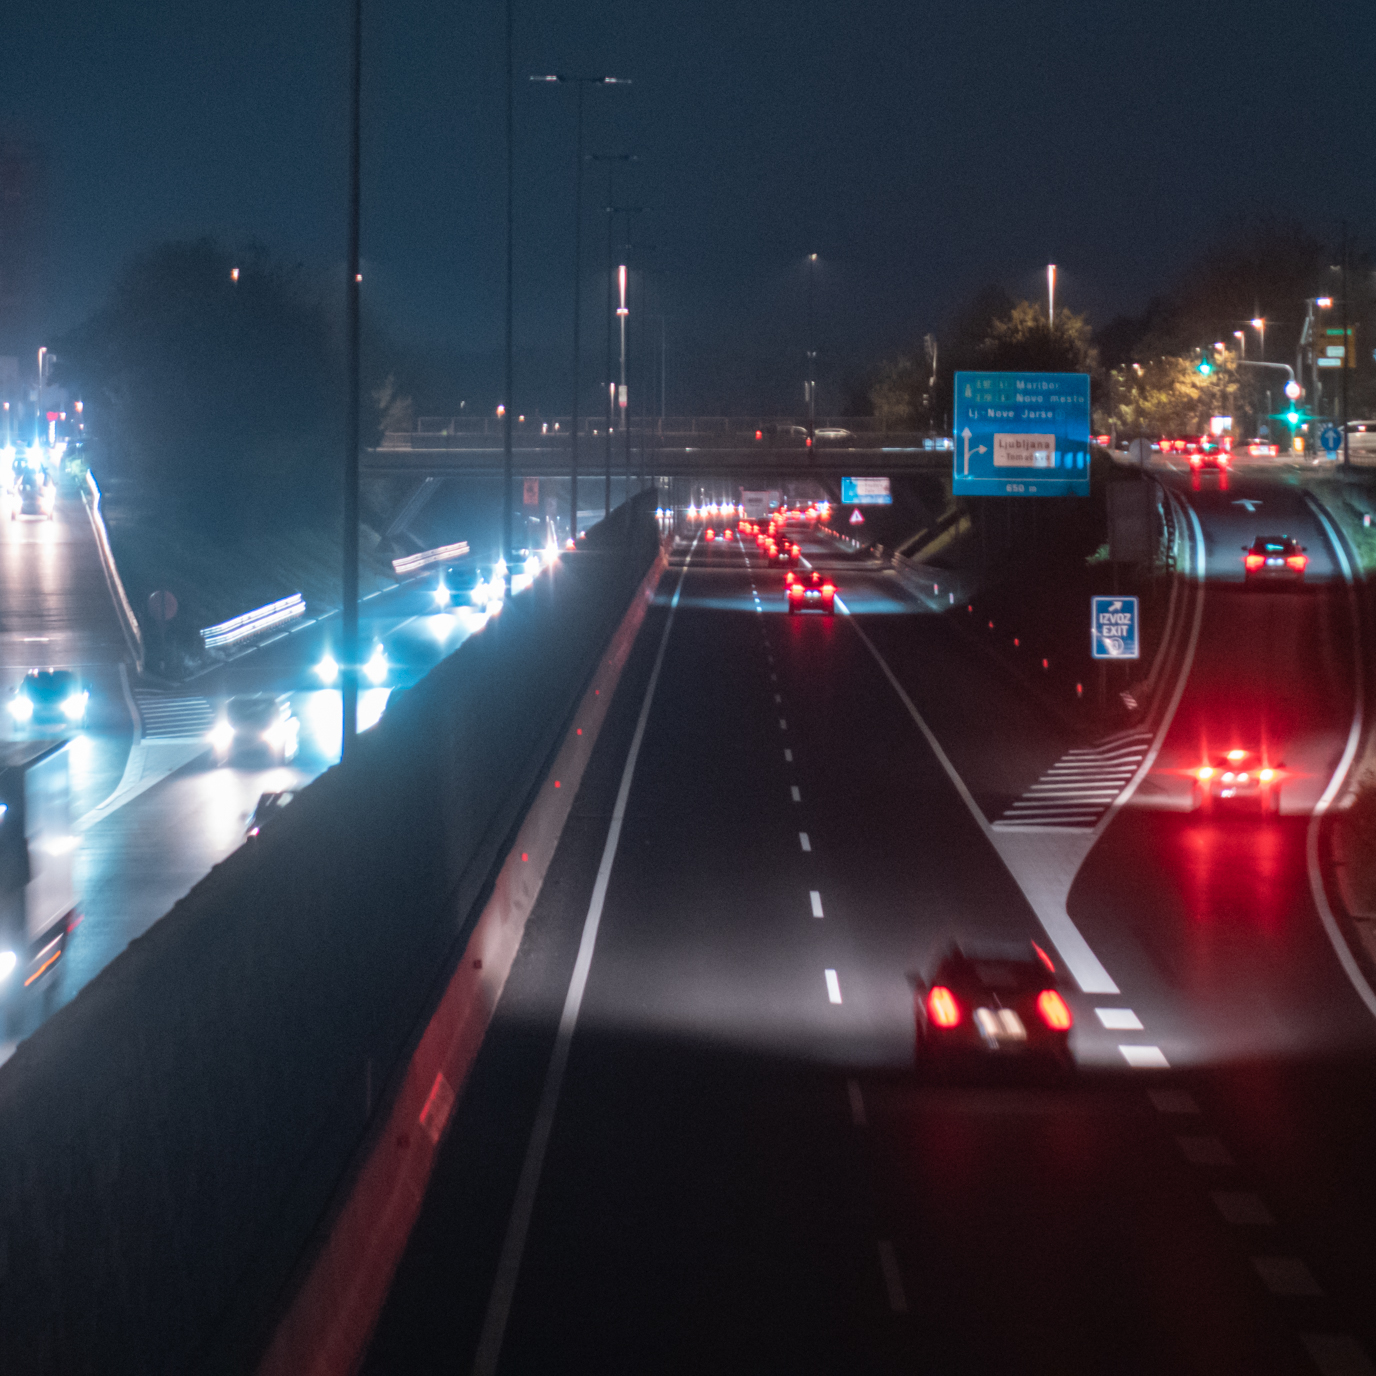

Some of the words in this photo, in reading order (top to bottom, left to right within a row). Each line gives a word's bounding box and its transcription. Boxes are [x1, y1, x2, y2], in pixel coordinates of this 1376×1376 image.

[1016, 379, 1059, 390] Maribor
[1016, 393, 1044, 403] Novo
[1050, 395, 1084, 404] mesto
[987, 408, 1015, 418] Nove
[999, 439, 1050, 450] Ljubljana
[1006, 484, 1025, 493] 650
[1028, 485, 1037, 493] m
[1099, 613, 1131, 624] IZVOZ
[1102, 625, 1129, 636] EXIT
